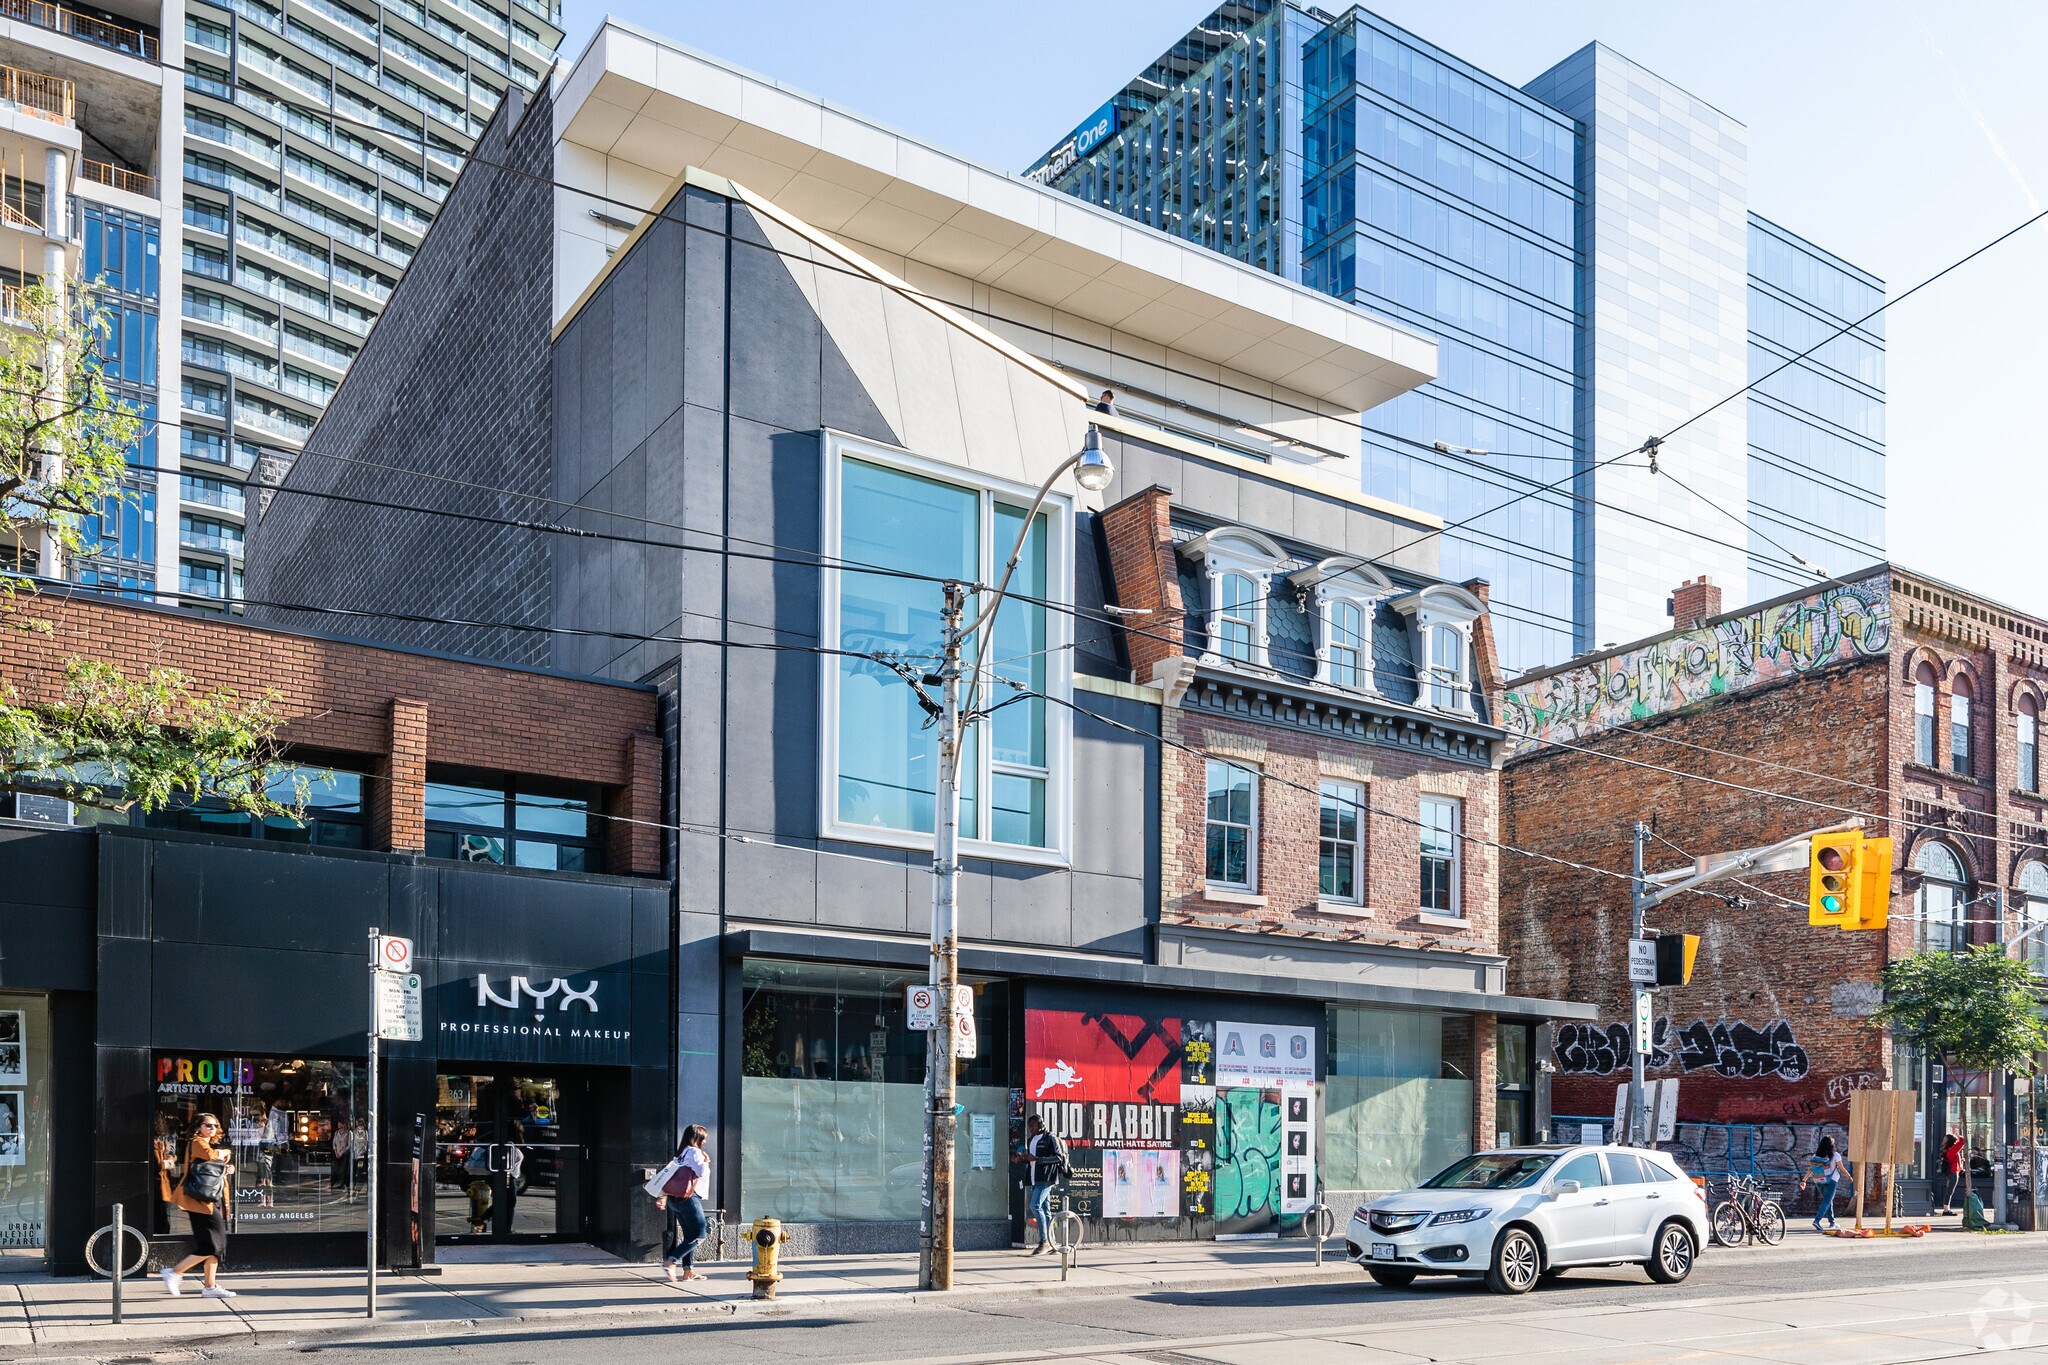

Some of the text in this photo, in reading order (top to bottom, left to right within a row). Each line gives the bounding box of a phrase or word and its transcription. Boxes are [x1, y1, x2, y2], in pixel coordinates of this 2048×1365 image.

[1078, 118, 1108, 152] One
[1639, 945, 1646, 954] NO
[1631, 957, 1655, 966] PEDESTRIAN
[1633, 967, 1654, 976] CROSSING
[478, 974, 598, 1012] NYX
[440, 1022, 630, 1039] PROFESSIONAL MAKEUP
[158, 1058, 253, 1084] PROUD
[158, 1084, 253, 1094] ARTISTRY FOR ALL
[1094, 1104, 1174, 1140] RABBIT
